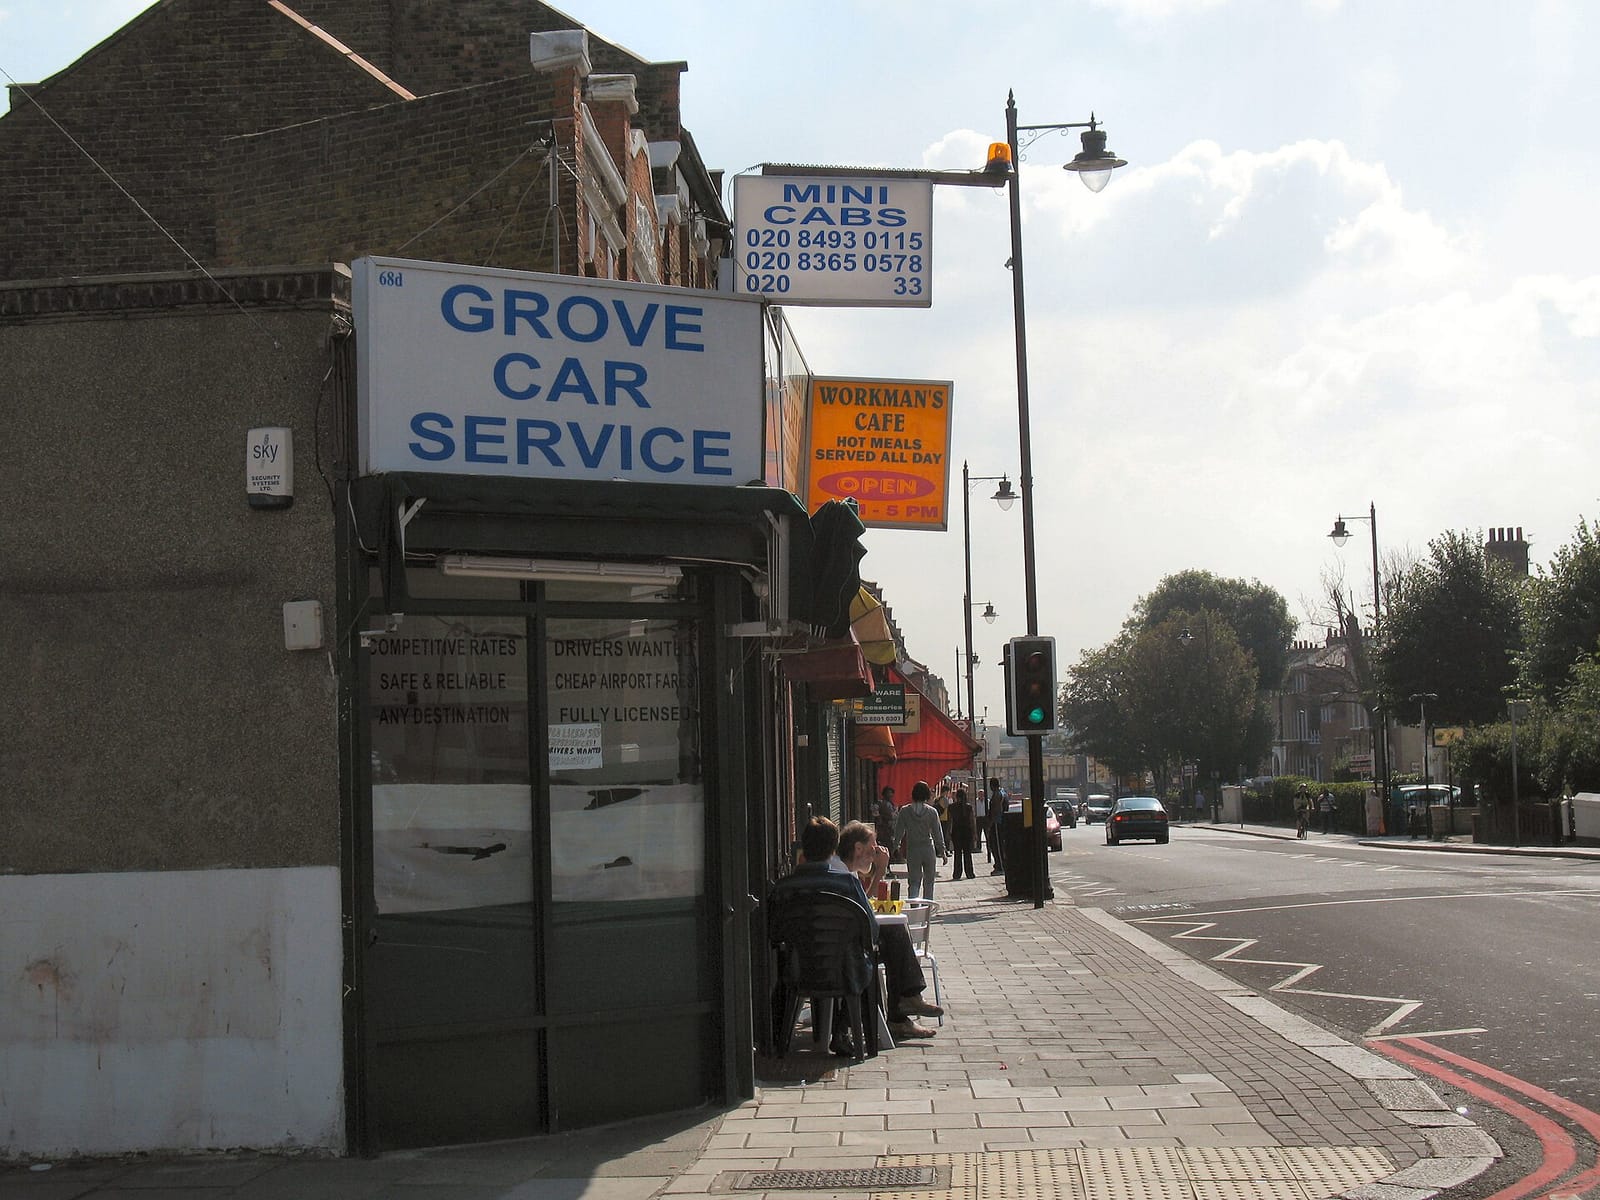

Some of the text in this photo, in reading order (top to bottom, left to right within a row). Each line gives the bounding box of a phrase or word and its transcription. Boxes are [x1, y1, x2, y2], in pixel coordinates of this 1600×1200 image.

[783, 184, 888, 205] MINI
[764, 206, 907, 227] CABS
[746, 228, 923, 250] 020 8493 0115
[746, 251, 923, 273] 020 8365 0578
[379, 270, 403, 288] 68d
[746, 274, 922, 295] 020 33
[440, 284, 705, 353] GROVE
[493, 352, 652, 409] CAR
[819, 386, 944, 409] WORKMAN'S
[855, 412, 905, 432] CAFE
[408, 412, 732, 476] SERVICE
[836, 436, 922, 450] HOT MEALS
[815, 449, 942, 464] SERVED ALL DAY
[836, 476, 917, 495] OPEN
[886, 504, 899, 517] 5
[906, 505, 938, 518] PM
[470, 639, 517, 655] RATES
[554, 640, 623, 657] DRIVERS
[380, 673, 506, 690] SAFE & RELIABLE
[555, 673, 597, 689] CHEAP
[600, 673, 653, 689] AIRPORT
[379, 707, 510, 725] ANY DESTINATION
[560, 707, 610, 723] FULLY
[549, 747, 575, 755] RIVERS
